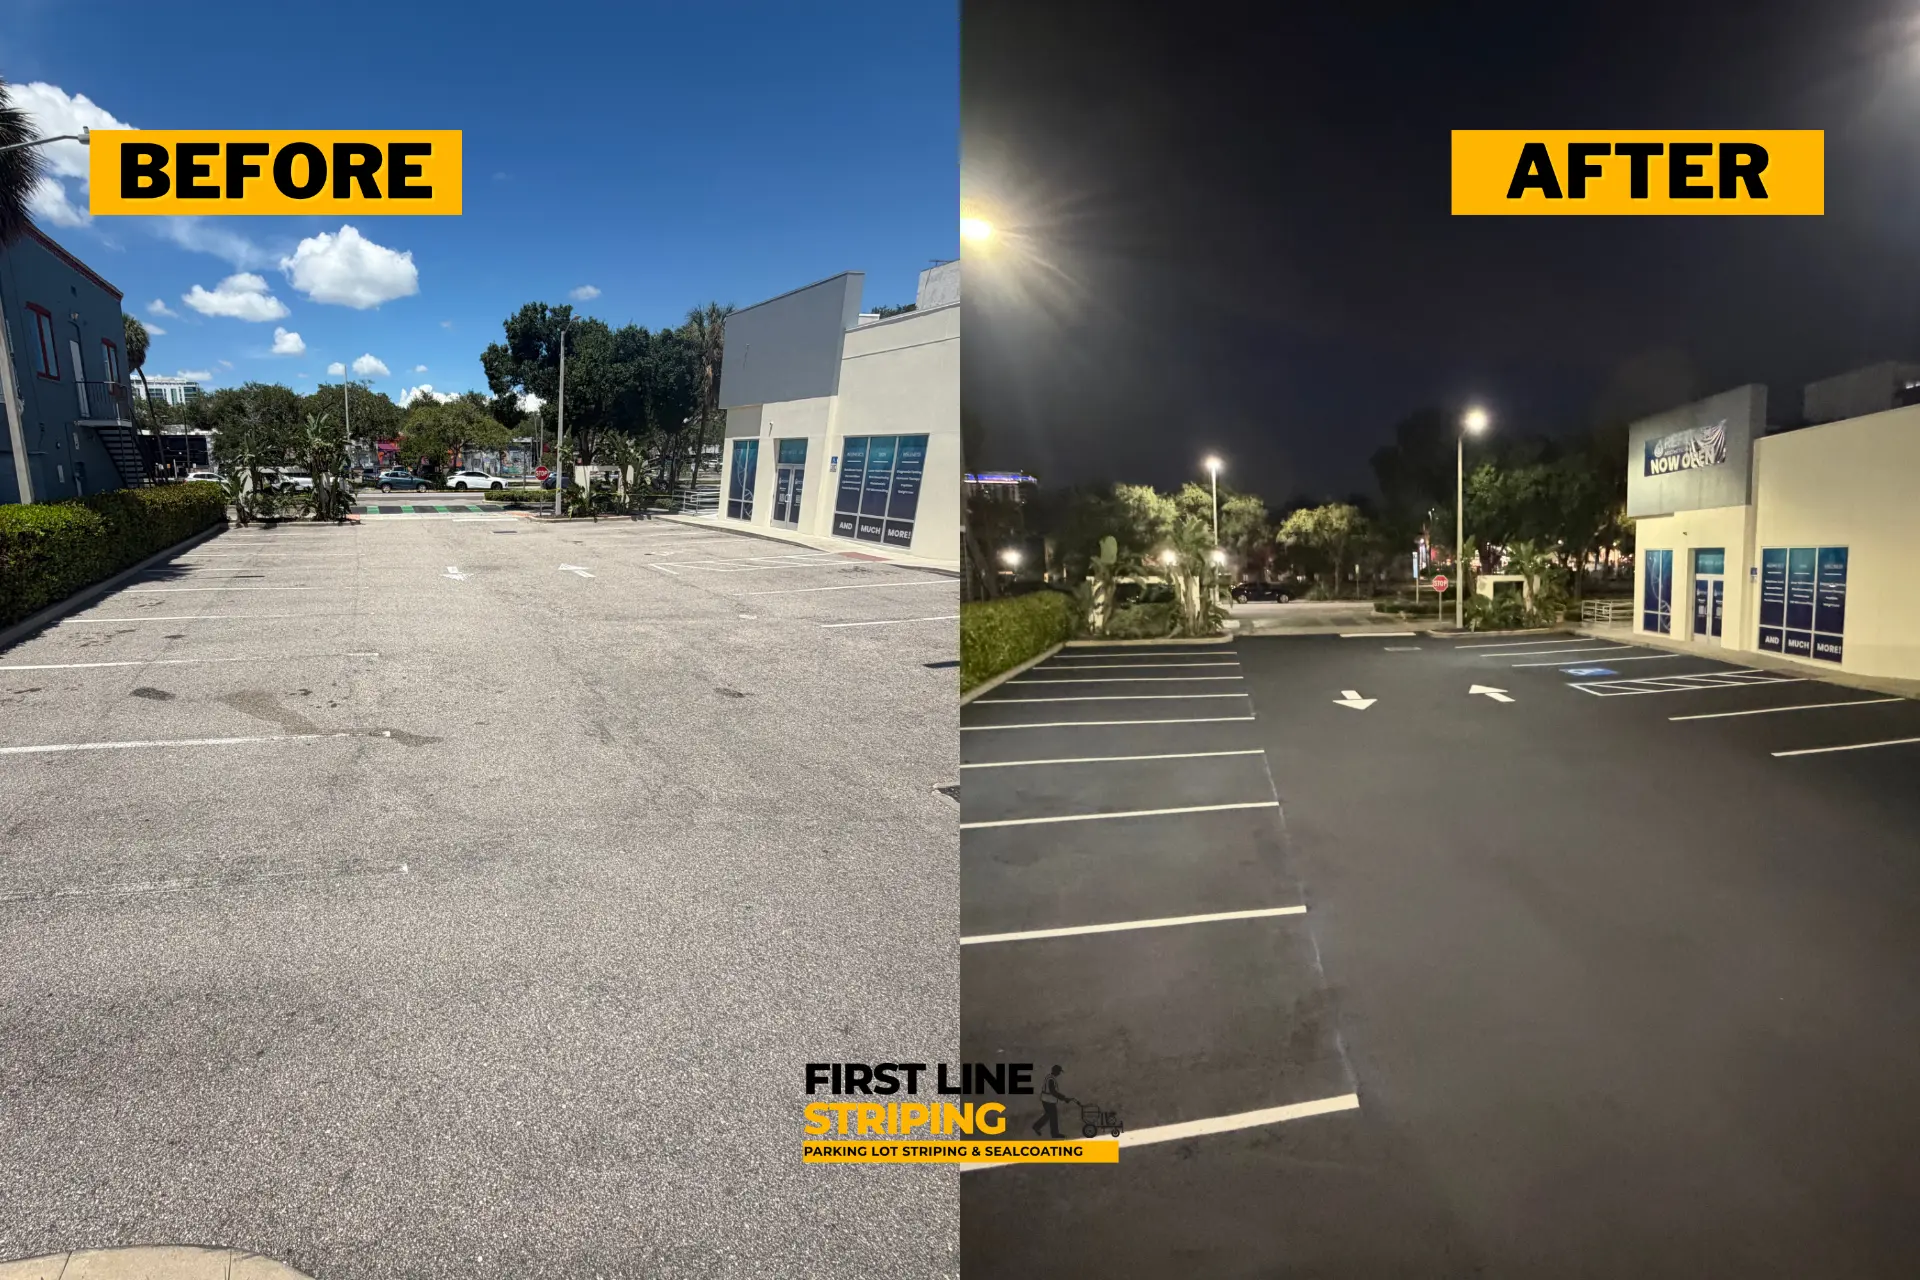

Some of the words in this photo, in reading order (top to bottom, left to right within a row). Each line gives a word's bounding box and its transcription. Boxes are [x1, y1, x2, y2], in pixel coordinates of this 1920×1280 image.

[1650, 454, 1680, 475] NOW
[839, 521, 853, 530] AND
[860, 524, 881, 535] MUCH
[887, 528, 912, 540] MORE!
[1765, 635, 1780, 645] AND
[1788, 638, 1810, 649] MUCH
[1817, 643, 1842, 655] MORE!
